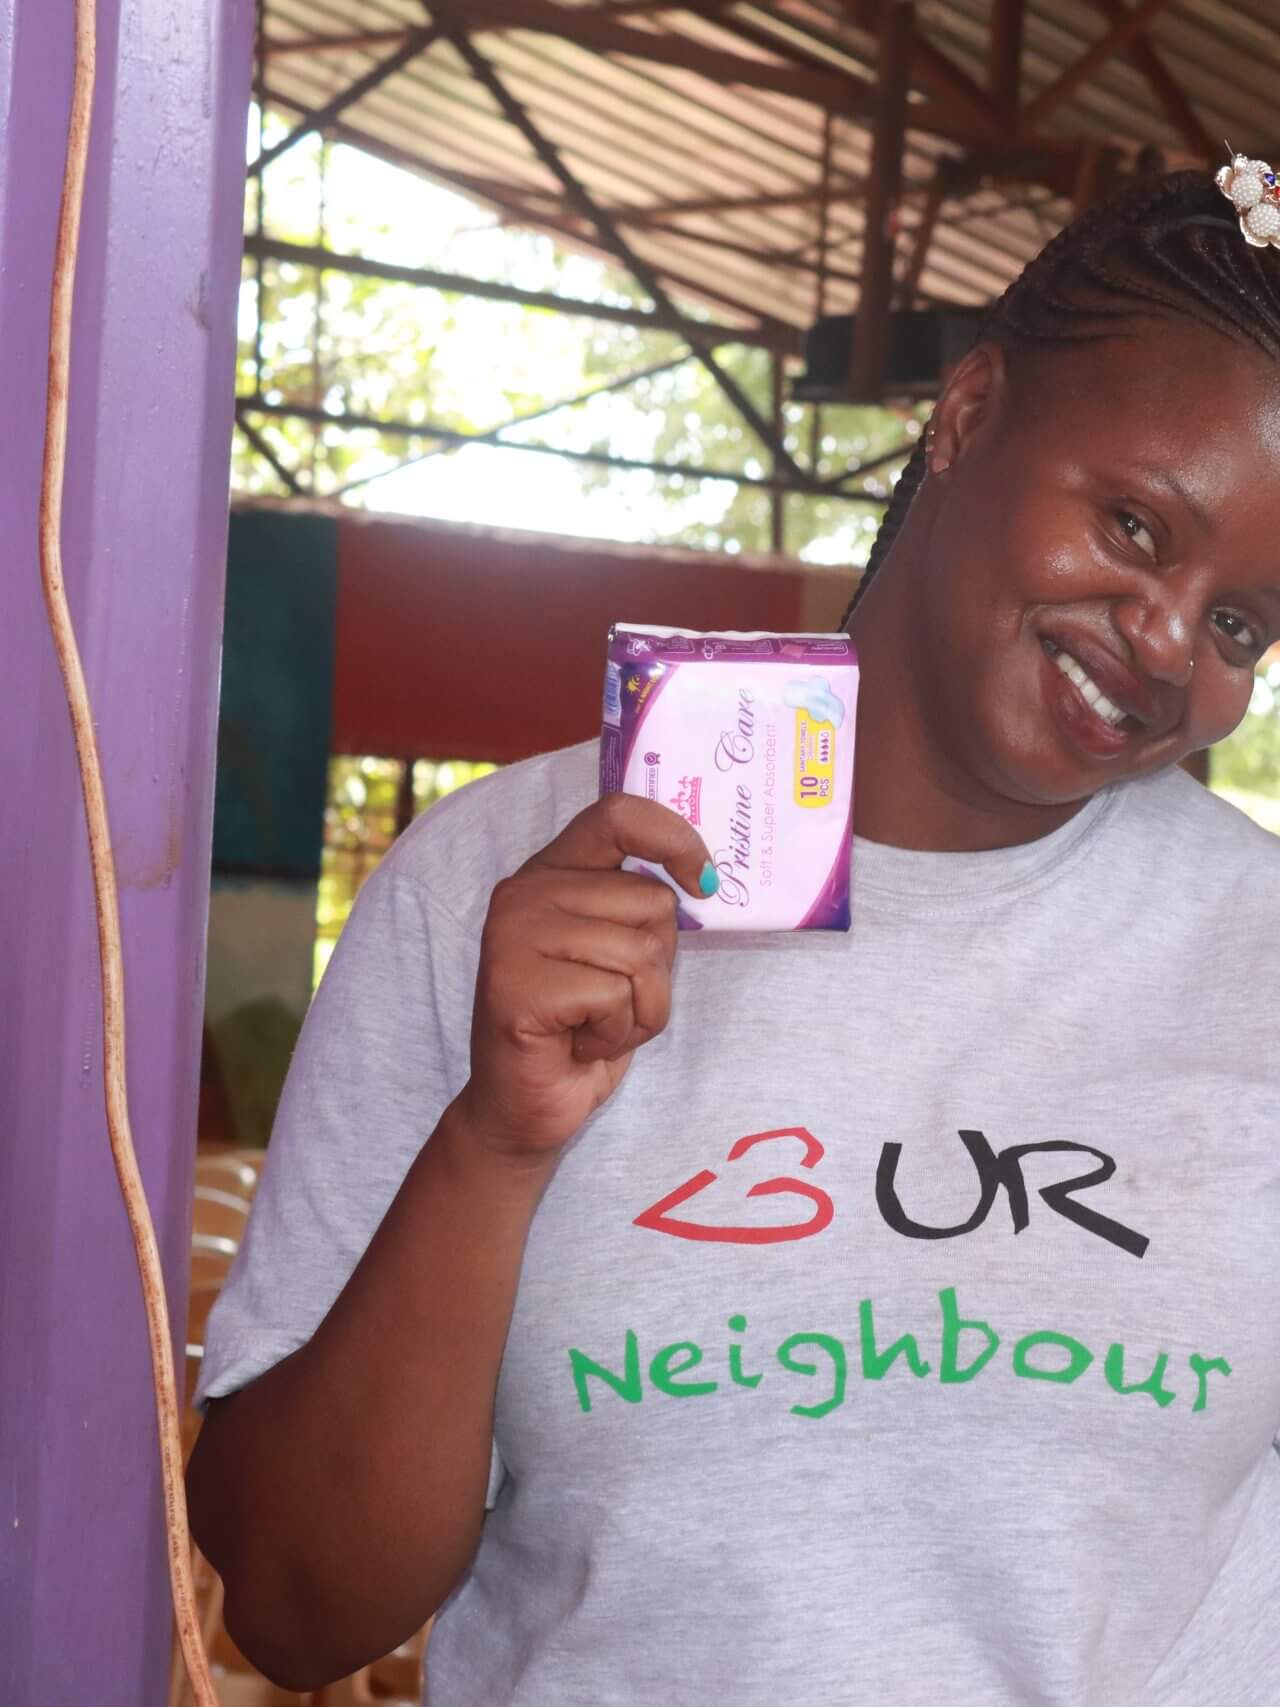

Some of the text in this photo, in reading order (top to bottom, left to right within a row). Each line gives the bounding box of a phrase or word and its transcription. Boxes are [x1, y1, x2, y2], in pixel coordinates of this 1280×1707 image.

[714, 687, 756, 772] Care
[800, 776, 818, 799] 10
[820, 778, 830, 797] PCS
[713, 784, 753, 907] Pristine
[760, 724, 777, 886] Soft & Super Absorbent
[874, 1128, 1151, 1259] UR
[566, 1287, 1232, 1419] Neighbour
